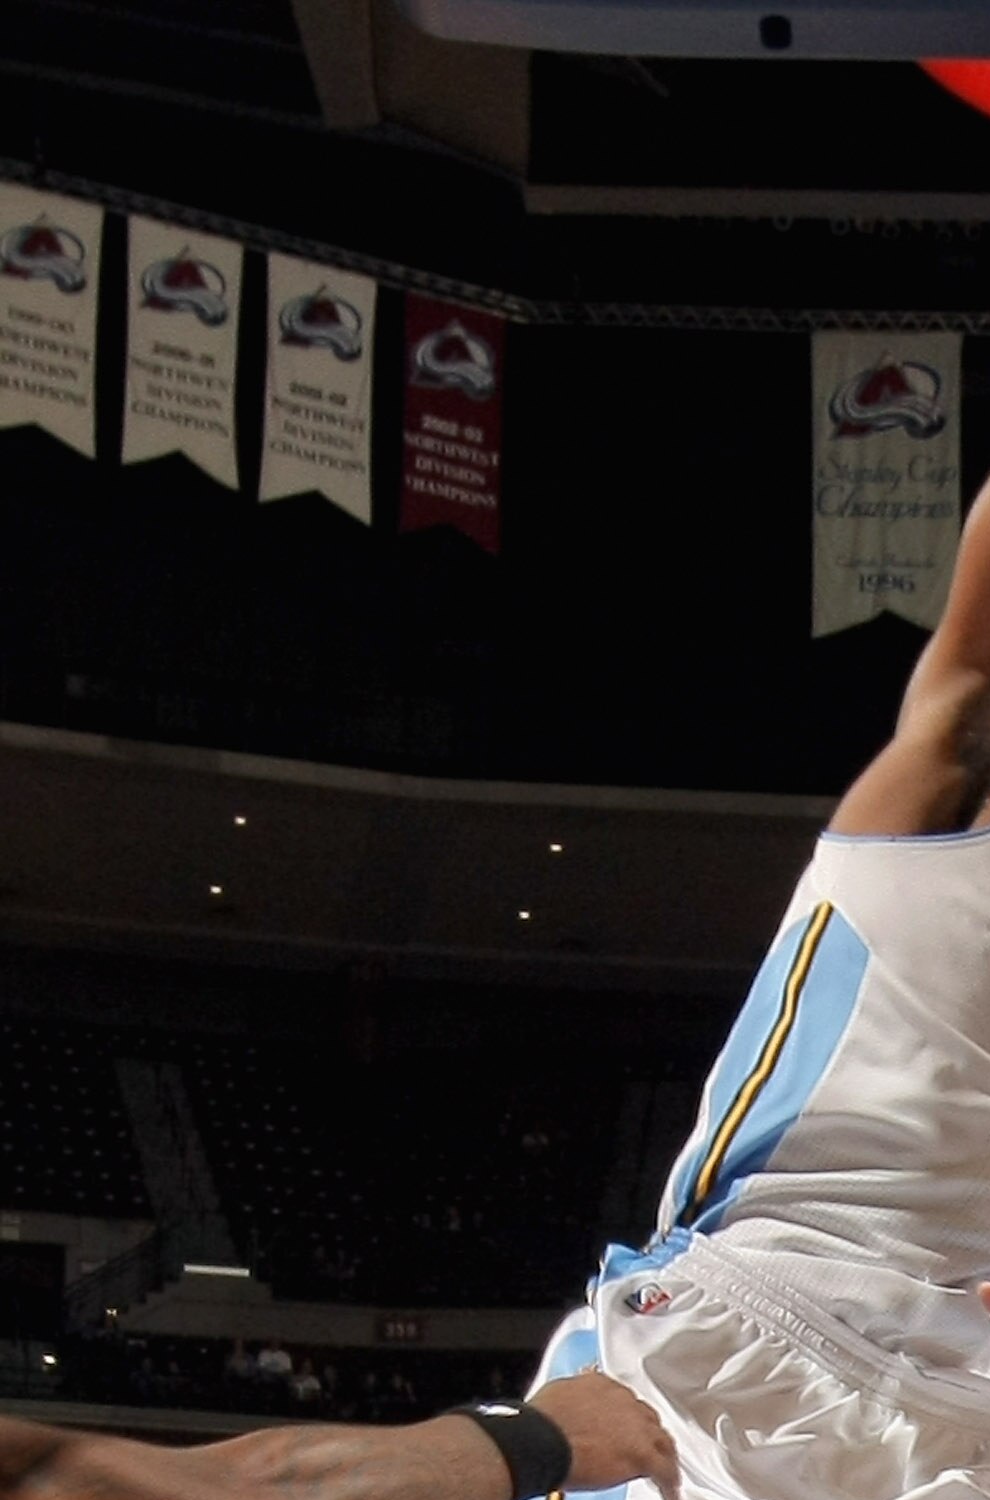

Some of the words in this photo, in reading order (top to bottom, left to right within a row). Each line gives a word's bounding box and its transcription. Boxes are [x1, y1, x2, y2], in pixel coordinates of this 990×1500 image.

[908, 455, 957, 489] Cup
[817, 481, 955, 522] Champions
[858, 573, 915, 593] 1996
